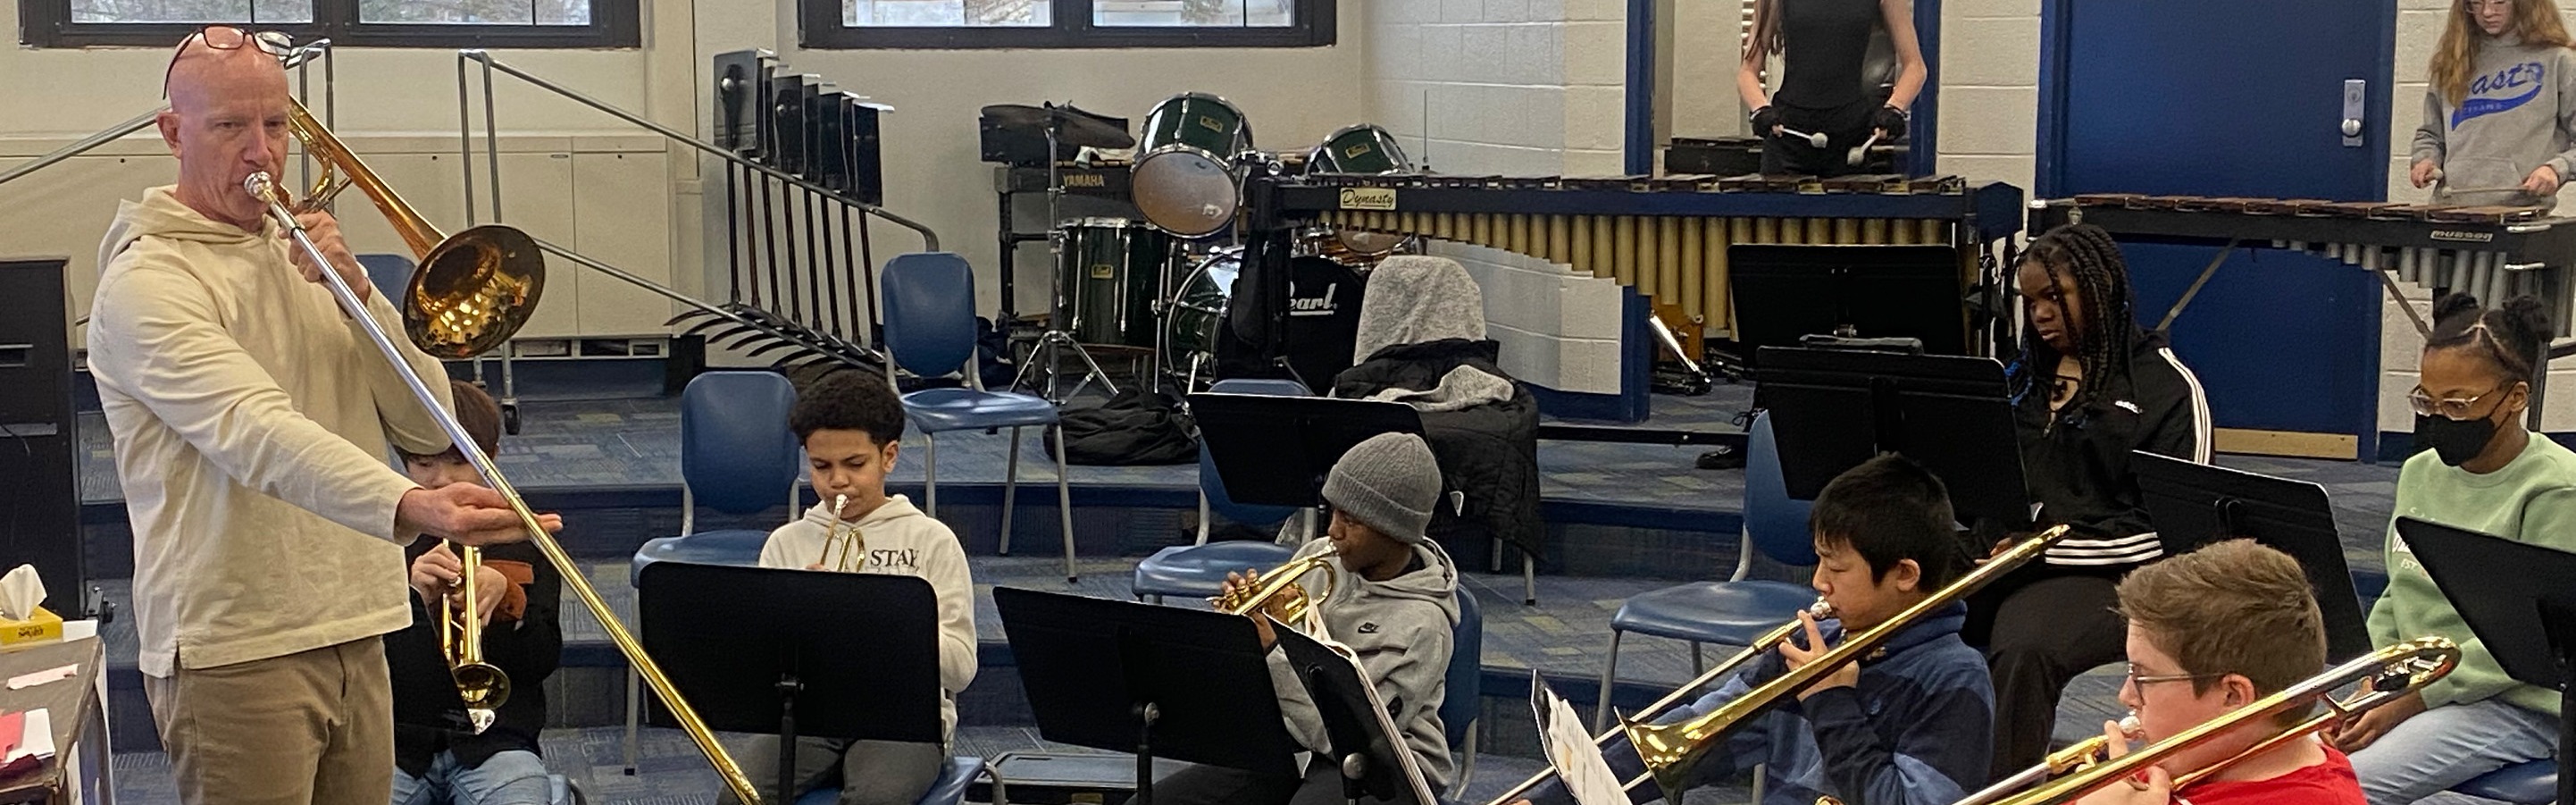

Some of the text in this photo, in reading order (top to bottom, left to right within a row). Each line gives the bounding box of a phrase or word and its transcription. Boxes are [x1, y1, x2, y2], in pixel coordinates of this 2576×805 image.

[2471, 63, 2526, 95] ast
[1063, 173, 1104, 187] YAMAHA
[1342, 189, 1393, 207] Dynasty
[870, 548, 919, 567] STAY
